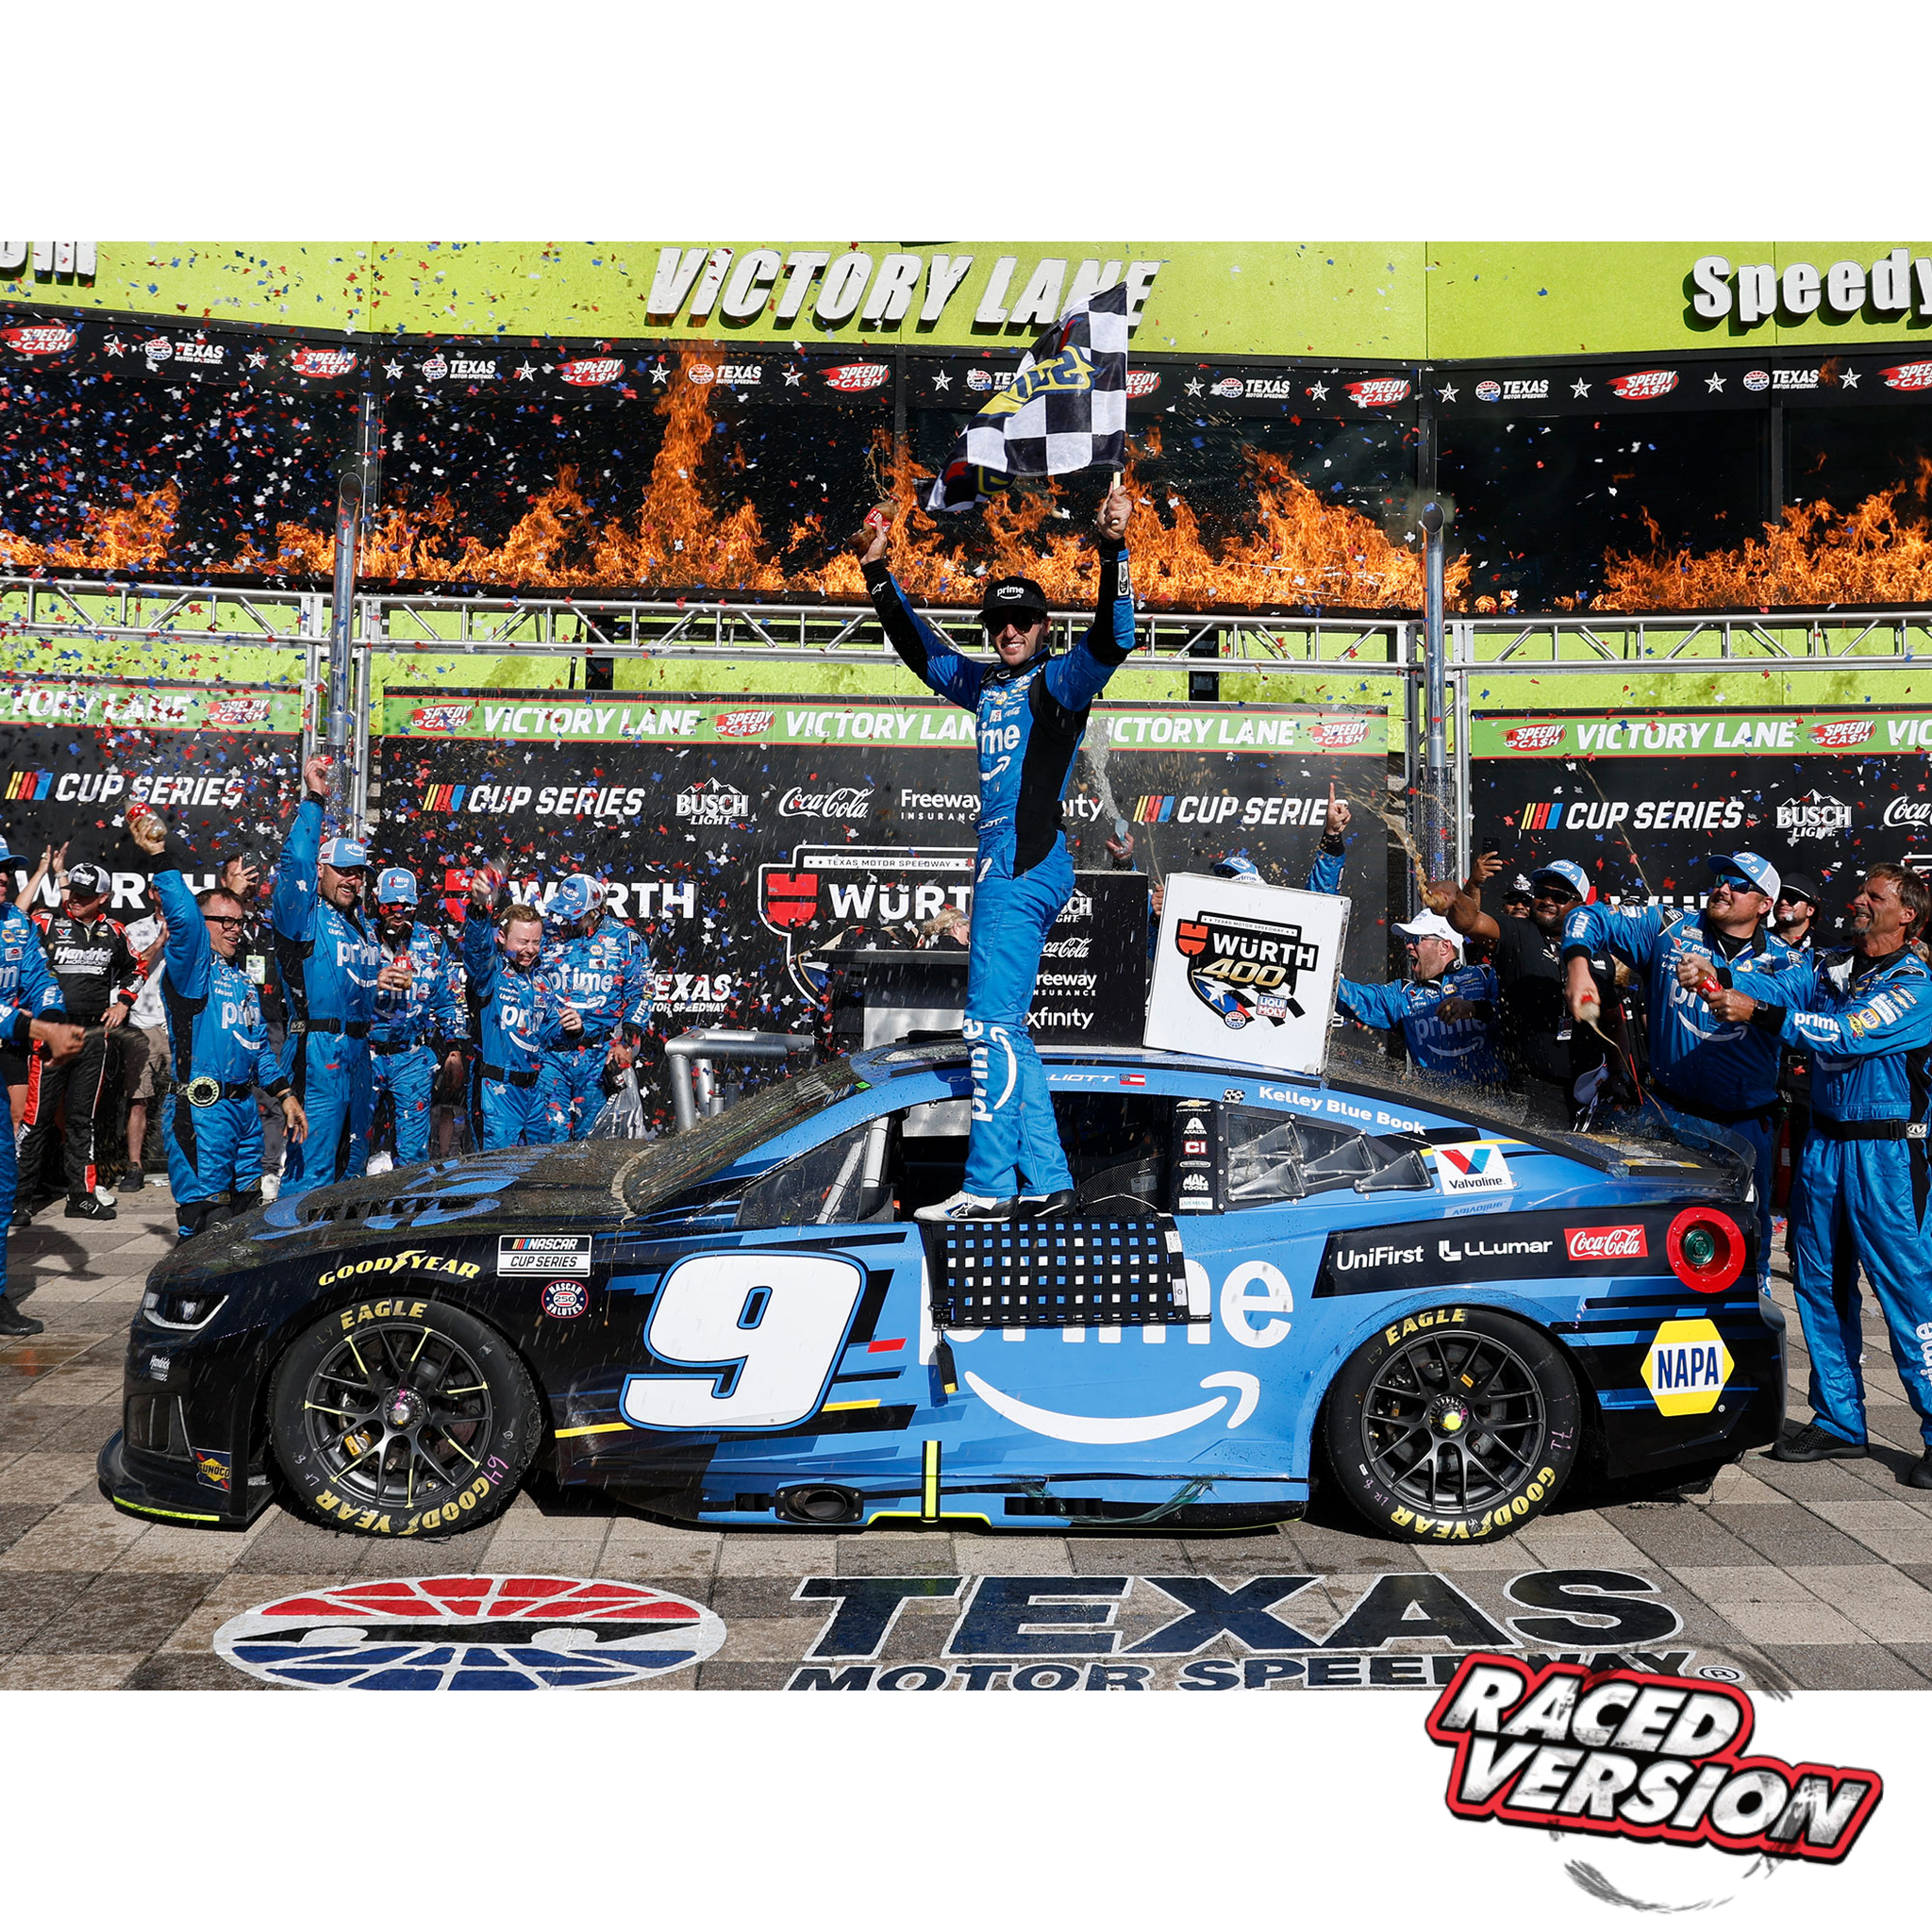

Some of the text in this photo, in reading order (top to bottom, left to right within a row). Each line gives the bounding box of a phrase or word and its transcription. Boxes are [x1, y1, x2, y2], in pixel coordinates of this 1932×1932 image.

[646, 246, 974, 321] VICTORY
[175, 342, 224, 359] TEXAS
[450, 360, 496, 375] TEXAS
[574, 358, 623, 374] SPEEDY
[717, 365, 762, 380] TEXAS
[839, 363, 889, 379] SPEEDY
[841, 375, 883, 388] CA$H
[1245, 379, 1291, 393] TEXAS
[1362, 378, 1410, 394] SPEEDY
[1627, 371, 1677, 389] SPEEDY
[1773, 371, 1819, 385] TEXAS
[1126, 382, 1155, 394] A$H
[1503, 380, 1550, 395] TEXAS
[1628, 384, 1672, 396] CA$H
[996, 586, 1024, 597] prime
[484, 706, 701, 736] VICTORY LANE
[726, 710, 775, 725] SPEEDY
[786, 711, 976, 741] VICTORY LAN
[1226, 719, 1296, 746] LANE
[1322, 722, 1368, 737] SPEEDY
[1517, 724, 1566, 741] SPEEDY
[1575, 723, 1799, 750] VICTORY LANE
[1824, 720, 1874, 737] SPEEDY
[1324, 734, 1365, 746] CA$H
[1518, 737, 1560, 748] CA$H
[1825, 732, 1871, 745] CA$H
[55, 773, 247, 807] CUP SERIES
[468, 785, 646, 816] CUP SERIES
[675, 795, 750, 818] BUSCH
[778, 786, 875, 820] Coca-Cola
[901, 789, 981, 813] Freeway
[901, 812, 976, 821] INSURANC
[1176, 795, 1349, 826] CUP SERIE
[1565, 800, 1745, 830] CUP SERIES
[1776, 806, 1853, 829] BUSCH
[690, 816, 731, 826] LIGHT
[827, 858, 952, 868] TEXAS MOTOR SPEEDWAY
[1747, 865, 1758, 874] 9
[1233, 921, 1254, 929] MOTOR
[1255, 924, 1285, 934] SPEEDWAY
[54, 946, 113, 965] Hendrick
[1041, 937, 1093, 958] ca-Cola
[1036, 973, 1097, 990] reeway
[1202, 958, 1287, 988] 400
[653, 973, 732, 1002] EXAS
[1259, 995, 1287, 1008] LIQUI
[1026, 1007, 1094, 1030] xfinity
[1257, 1006, 1286, 1018] MOLY
[1046, 1074, 1116, 1083] LIOTT
[1258, 1086, 1426, 1137] Kelley Blue Book
[1184, 1141, 1208, 1154] CI
[1449, 1175, 1506, 1191] Valvoline
[527, 1238, 578, 1251] NASCAR
[1569, 1226, 1643, 1259] Coca-Cola
[510, 1255, 578, 1268] CUP SERIES
[1337, 1244, 1424, 1272] UniFirst
[318, 1249, 482, 1287] GOODYEAR
[548, 1282, 582, 1295] NASCAR
[340, 1299, 428, 1331] EAGLE
[547, 1301, 584, 1317] SALUTES
[1385, 1308, 1468, 1347] EAGLE
[623, 1253, 865, 1429] 9
[1657, 1346, 1720, 1390] NAPA
[198, 1463, 231, 1478] SUNOCO
[794, 1570, 1685, 1662] TEXAS
[783, 1662, 1157, 1690] MOTOR
